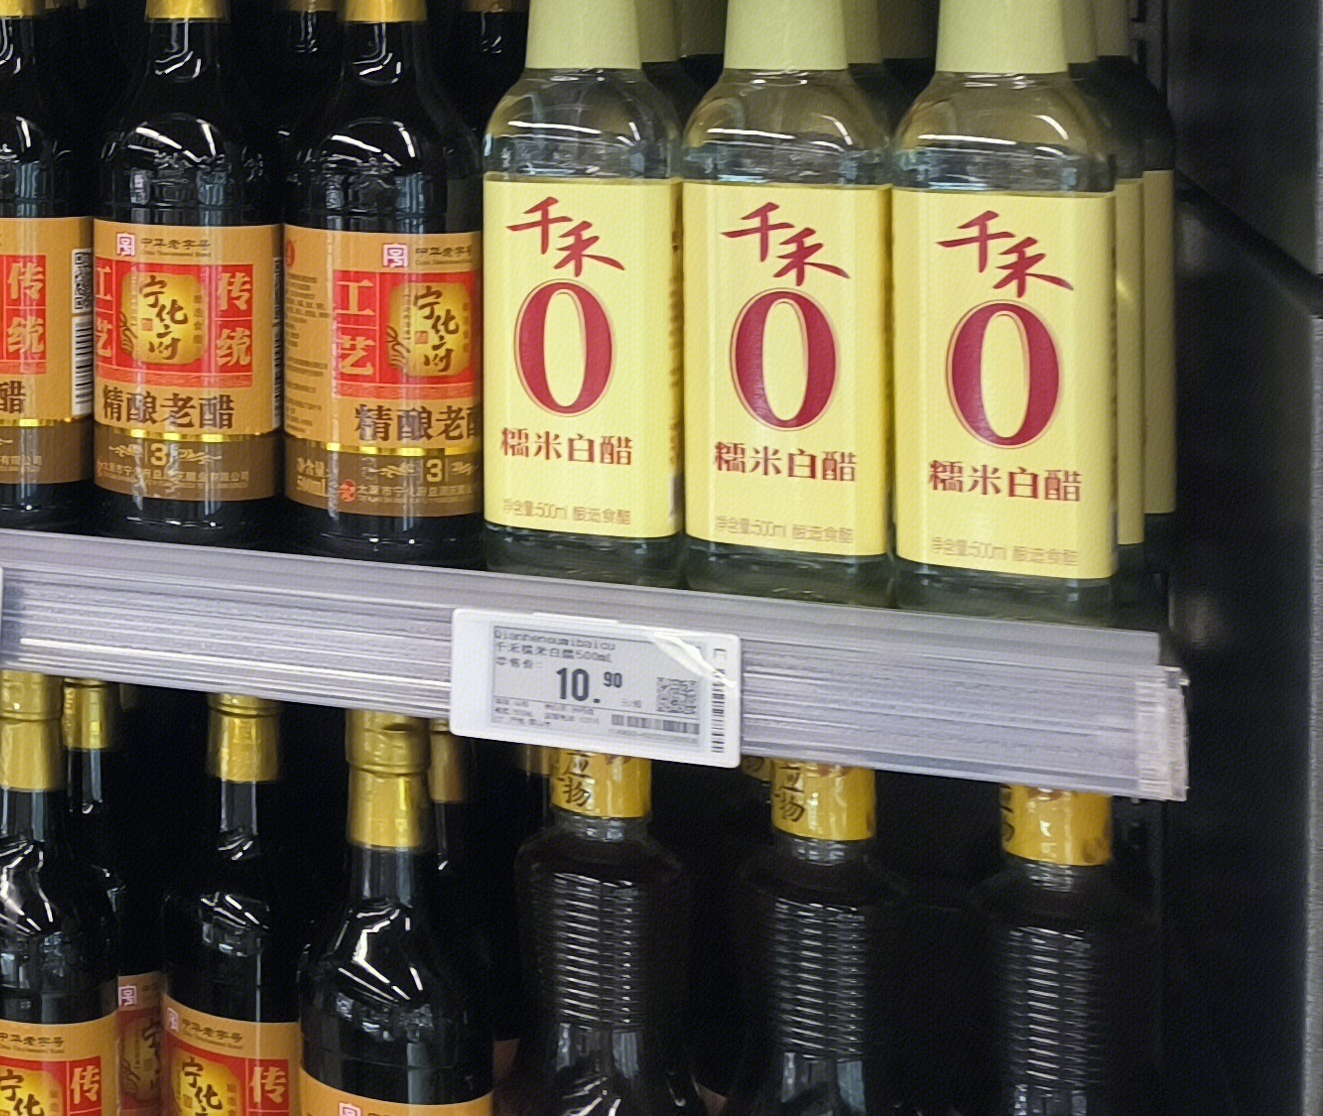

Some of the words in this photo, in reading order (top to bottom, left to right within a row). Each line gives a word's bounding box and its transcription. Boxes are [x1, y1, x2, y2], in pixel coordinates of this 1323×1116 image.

[505, 197, 625, 275] 千禾
[721, 202, 851, 286] 千禾
[936, 210, 1074, 299] 千禾
[7, 259, 46, 356] 传统
[218, 271, 253, 368] 传统
[336, 277, 376, 376] 工艺
[512, 278, 615, 417] 0
[729, 286, 838, 432] 0
[944, 298, 1062, 450] 0
[102, 383, 235, 430] 精酿老醋
[500, 426, 634, 467] 糯米白醋
[150, 442, 166, 466] 3
[426, 458, 443, 482] 3
[713, 441, 857, 484] 糯米白醋
[928, 459, 1082, 503] 糯米白醋
[556, 667, 623, 704] 10.90
